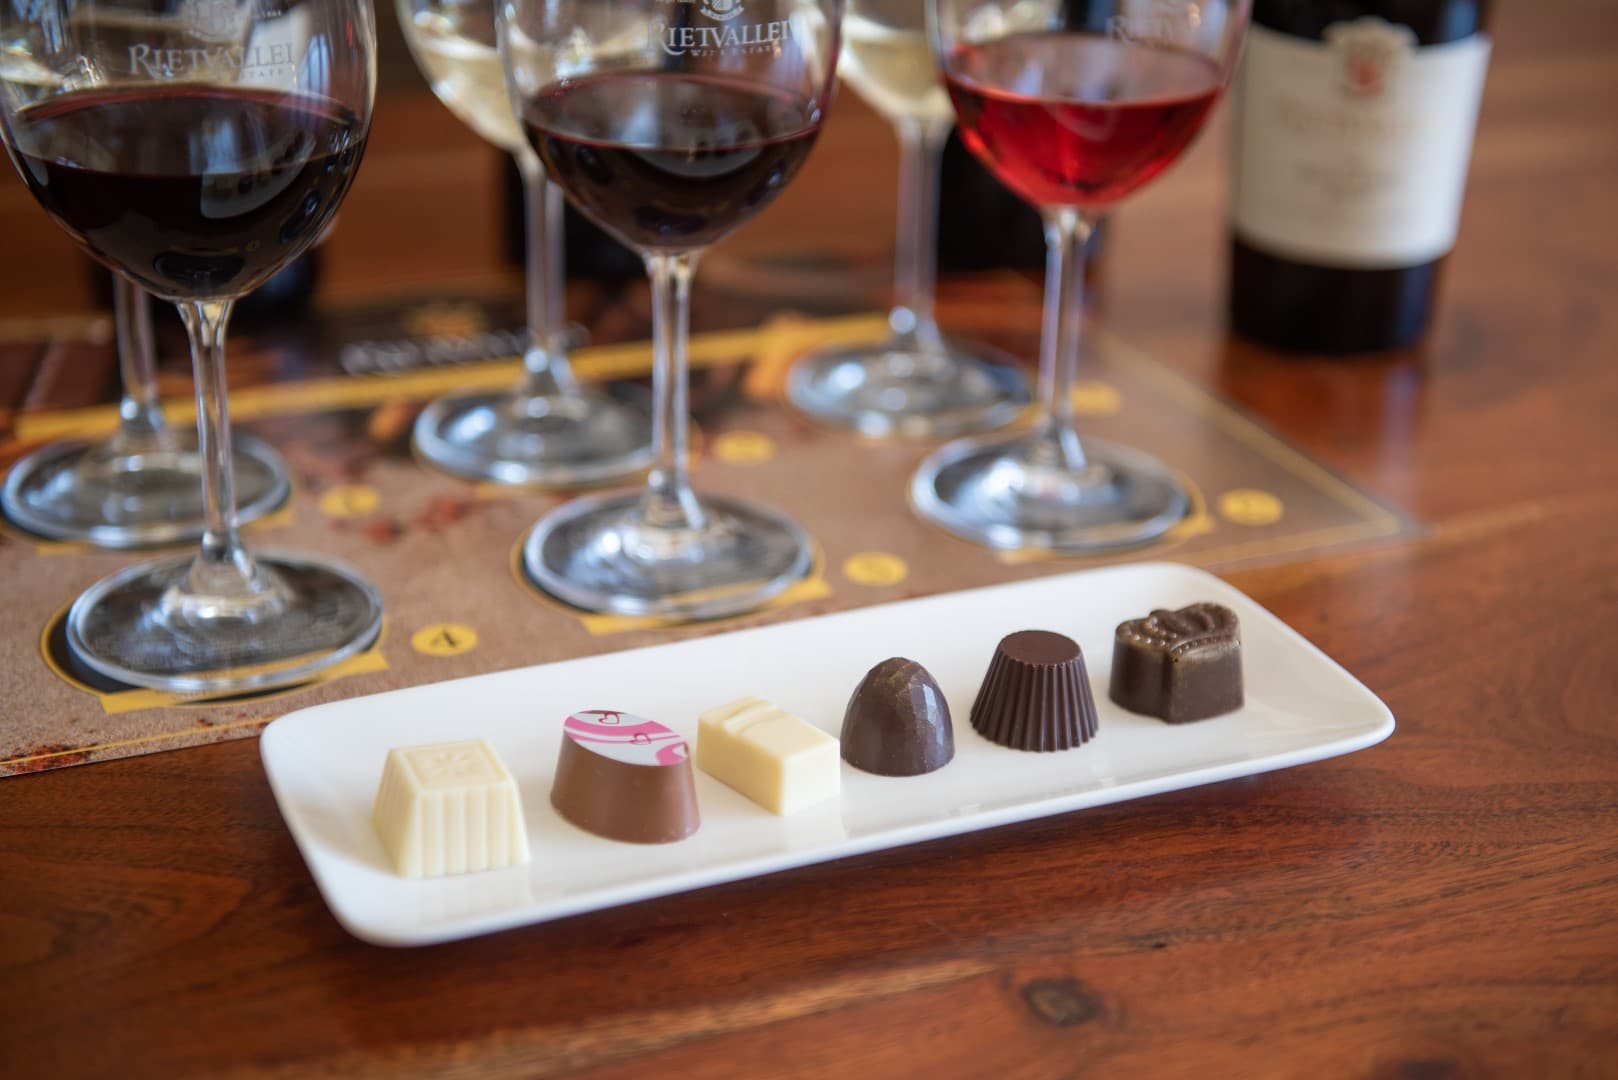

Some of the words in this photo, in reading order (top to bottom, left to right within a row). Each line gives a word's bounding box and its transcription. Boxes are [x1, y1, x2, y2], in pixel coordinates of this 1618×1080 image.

[648, 20, 792, 56] RIETVALLEI
[127, 42, 296, 81] RIETVALLEI
[429, 629, 462, 649] A
